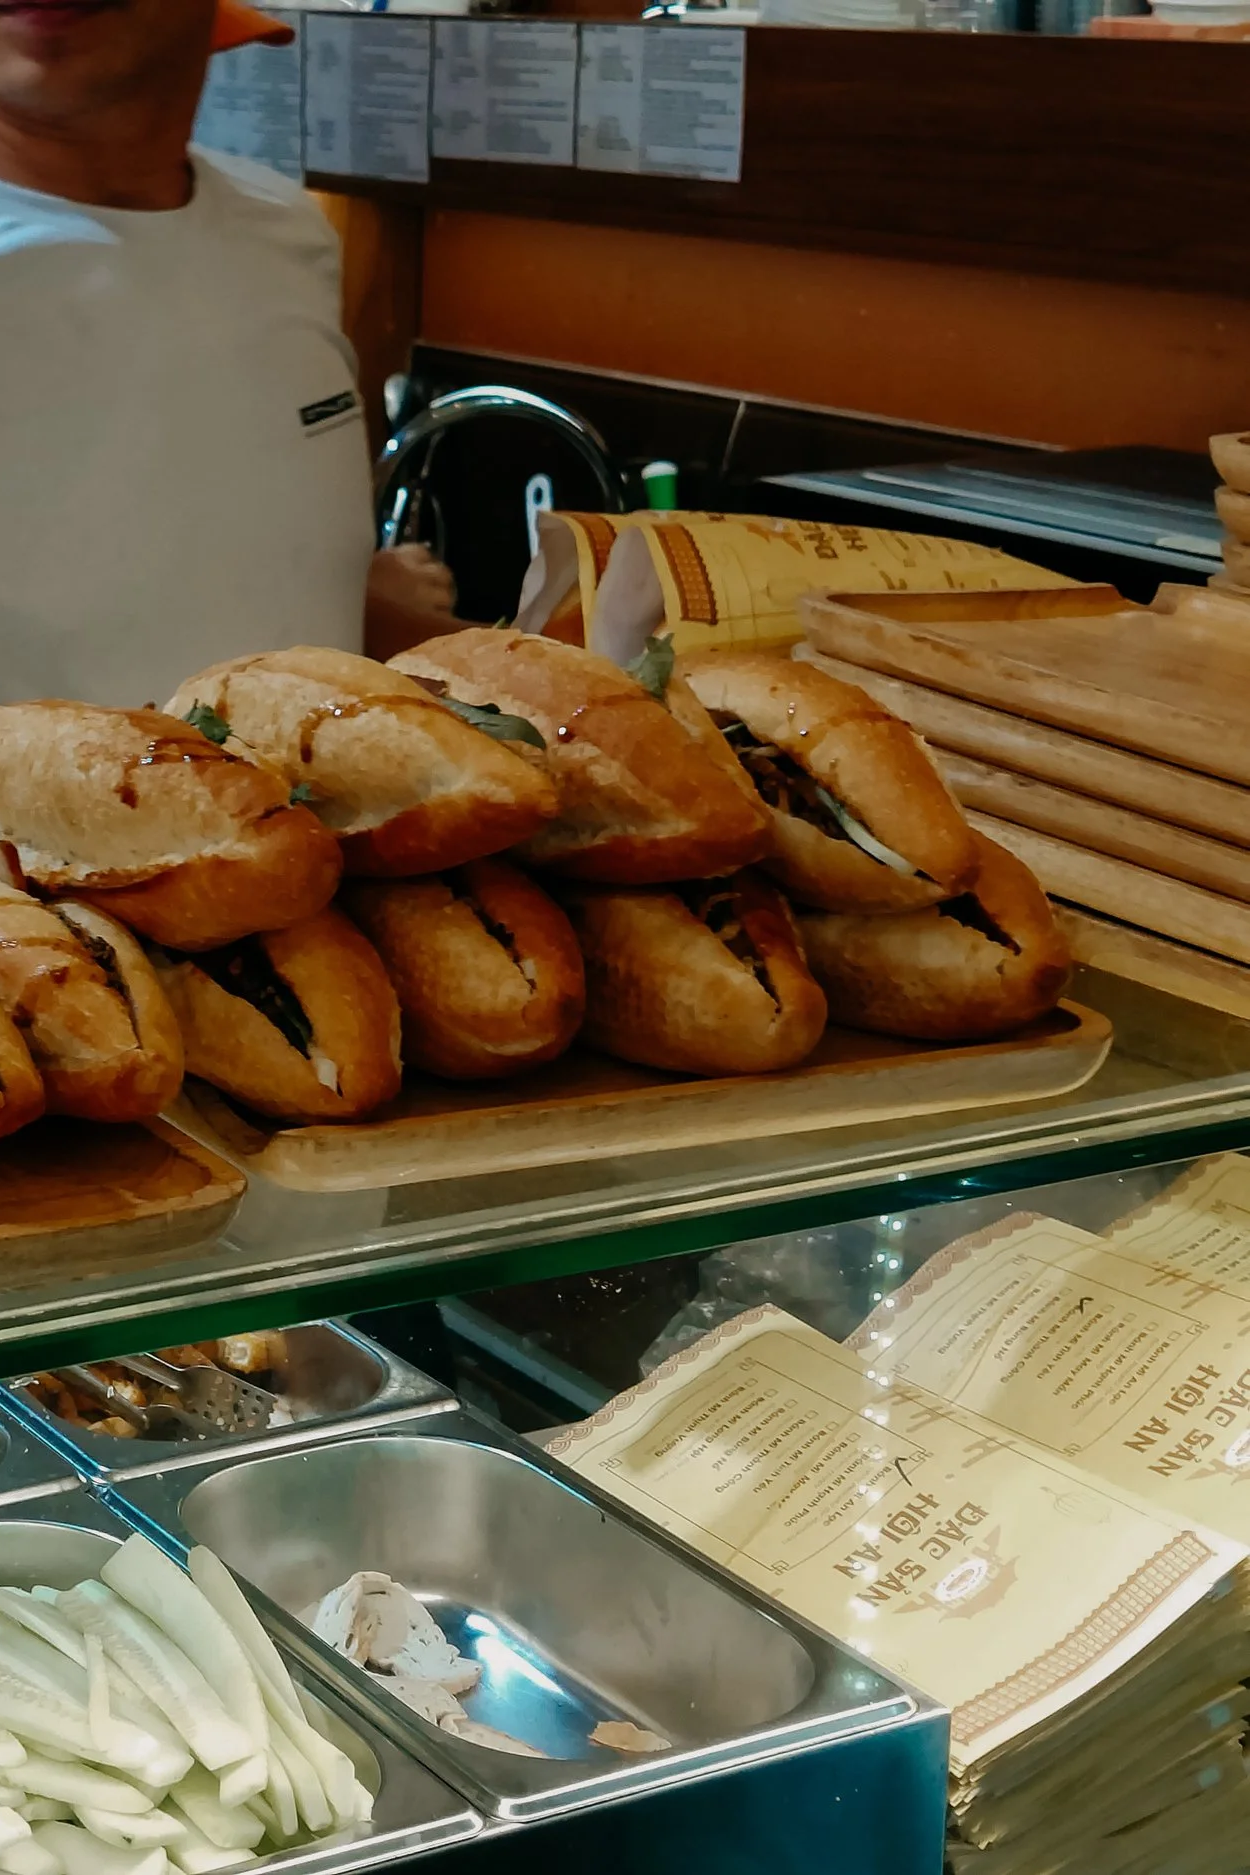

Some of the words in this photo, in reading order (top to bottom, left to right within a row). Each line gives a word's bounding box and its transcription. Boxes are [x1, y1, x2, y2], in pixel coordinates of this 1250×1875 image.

[1163, 1364, 1222, 1416] HỘI
[1122, 1416, 1171, 1454] AN
[1147, 1428, 1215, 1477] SẢN
[839, 1498, 855, 1511] An
[880, 1492, 941, 1543] HỘI
[919, 1501, 990, 1561] ĐẶC
[833, 1542, 882, 1580] AN
[854, 1558, 927, 1608] SẢN
